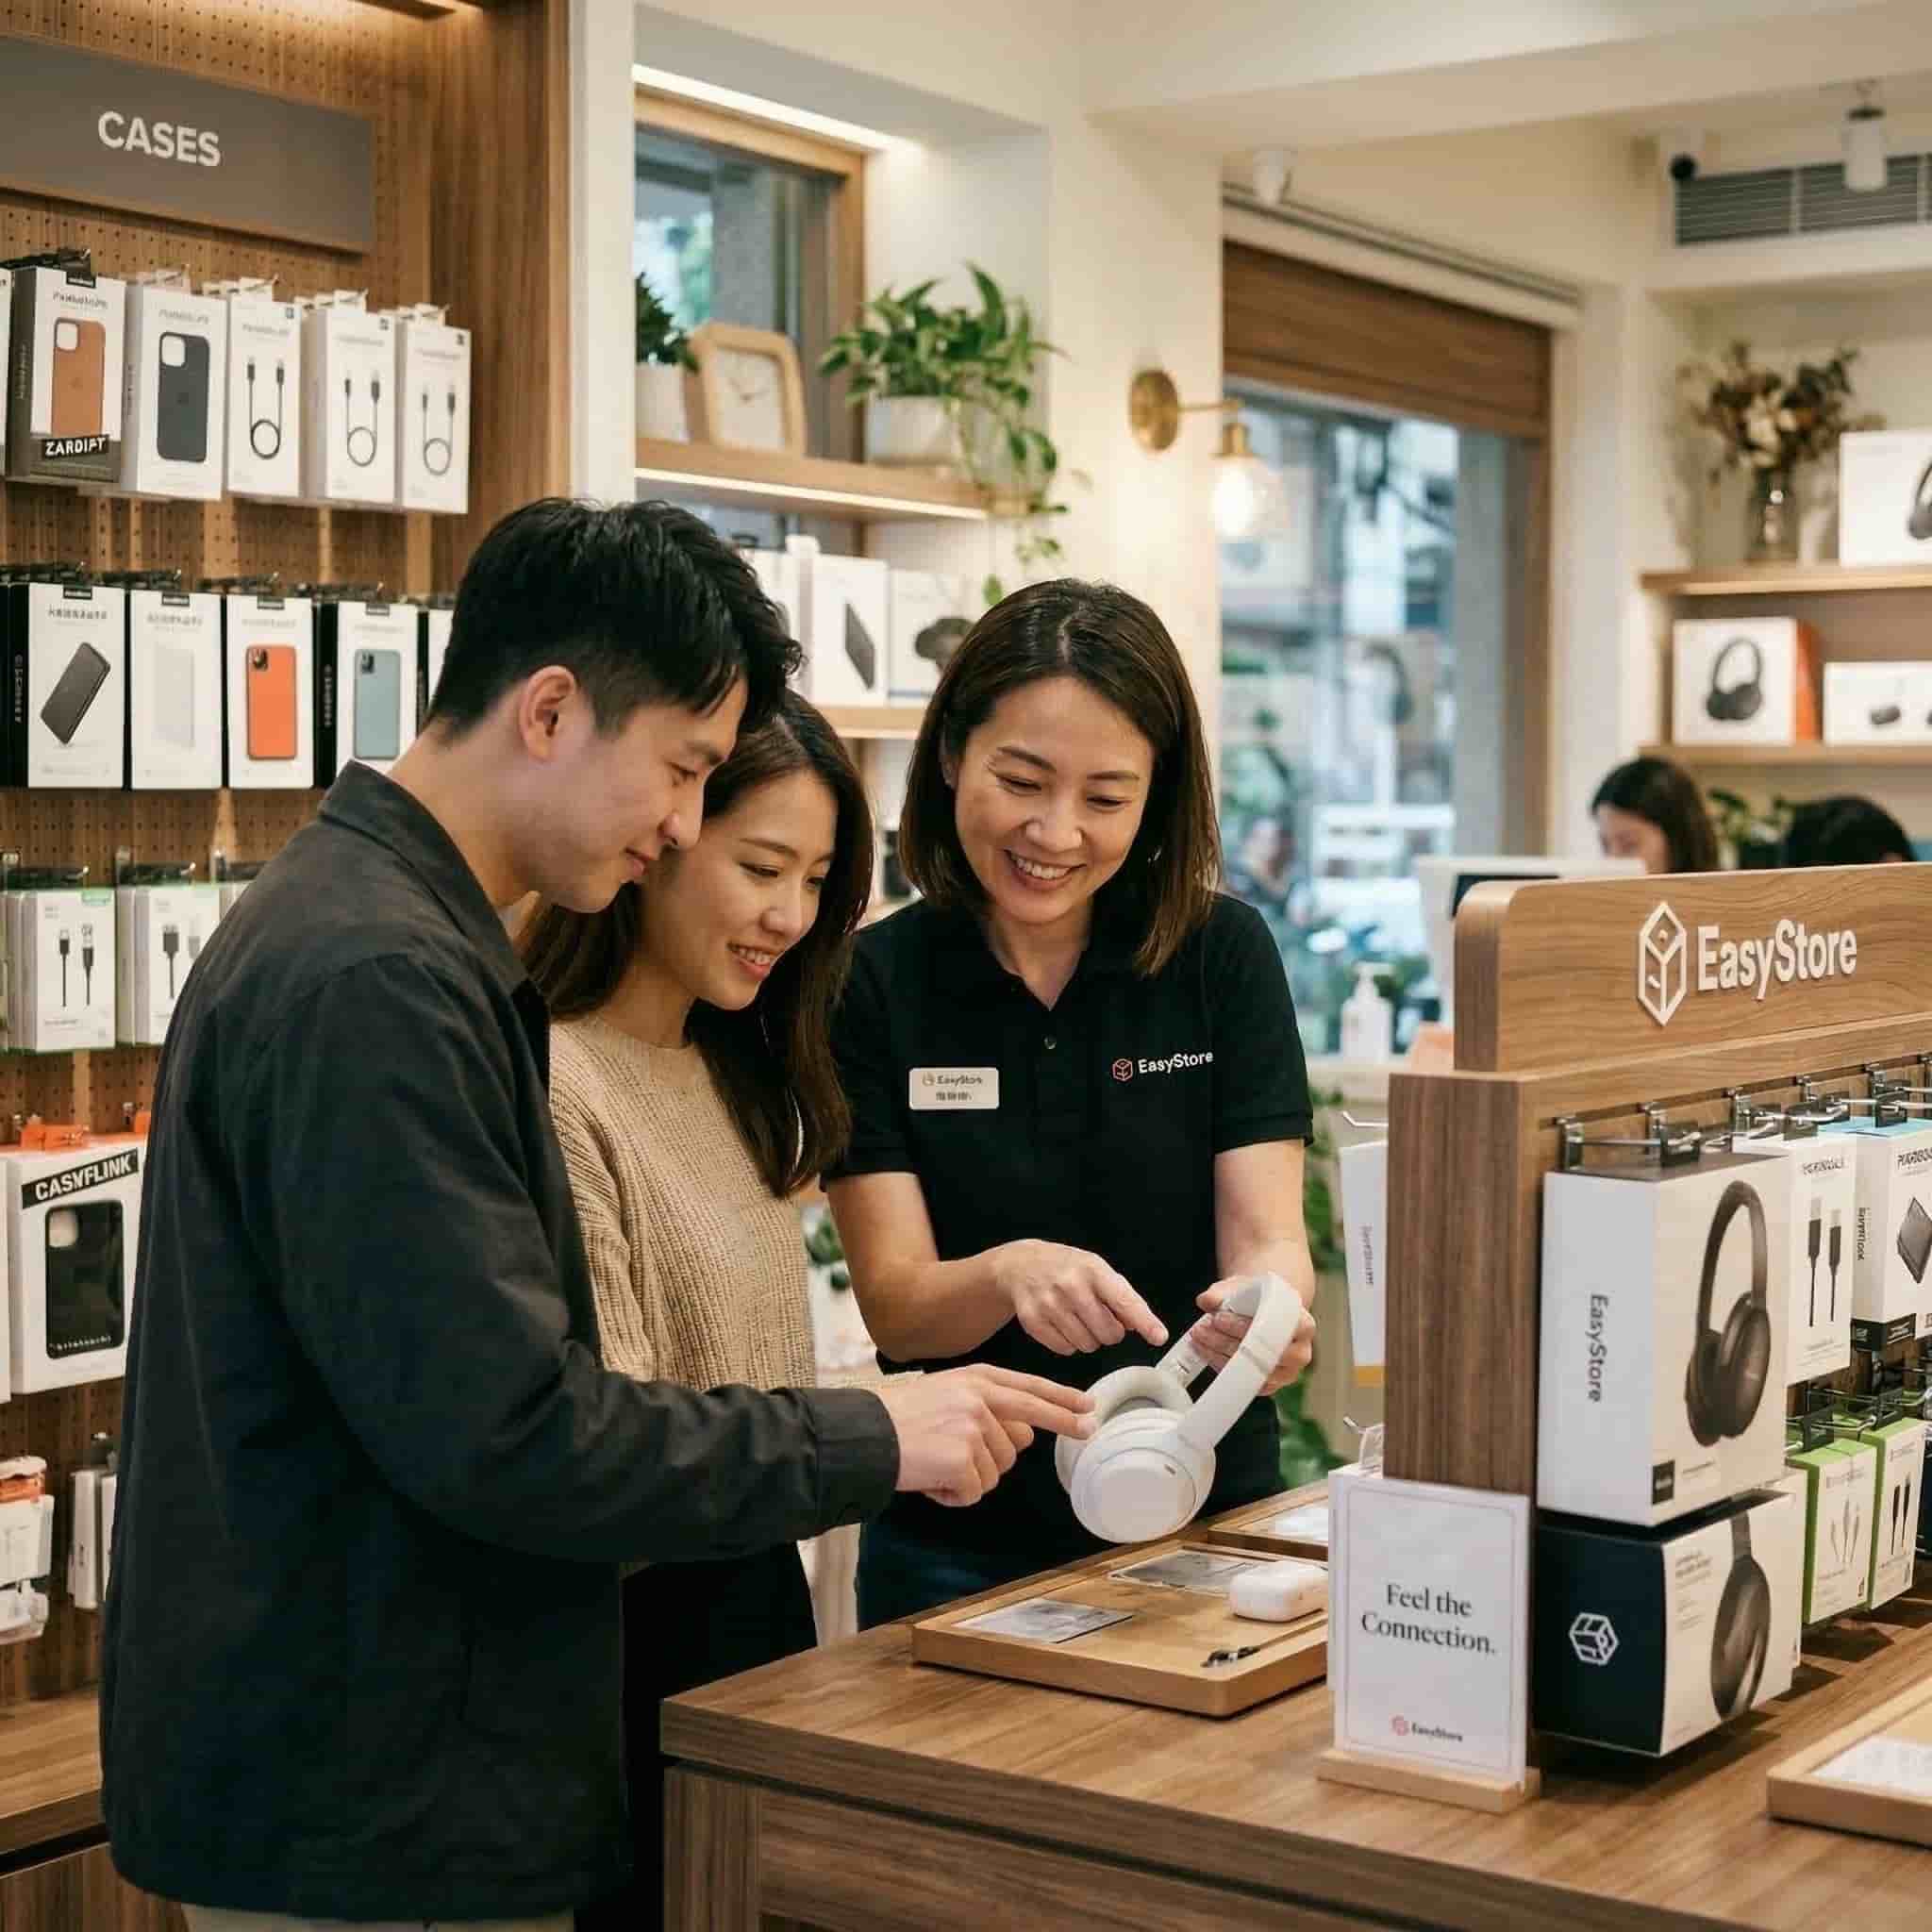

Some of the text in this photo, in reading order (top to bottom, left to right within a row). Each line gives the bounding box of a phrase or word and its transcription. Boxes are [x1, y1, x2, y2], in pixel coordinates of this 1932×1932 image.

[98, 110, 221, 167] CASES
[1697, 918, 1857, 1002] EasyStore
[1138, 1051, 1214, 1074] EasyStore
[1585, 1293, 1609, 1403] EasyStore
[1387, 1583, 1473, 1617] Feel the
[1361, 1610, 1495, 1654] Connection.
